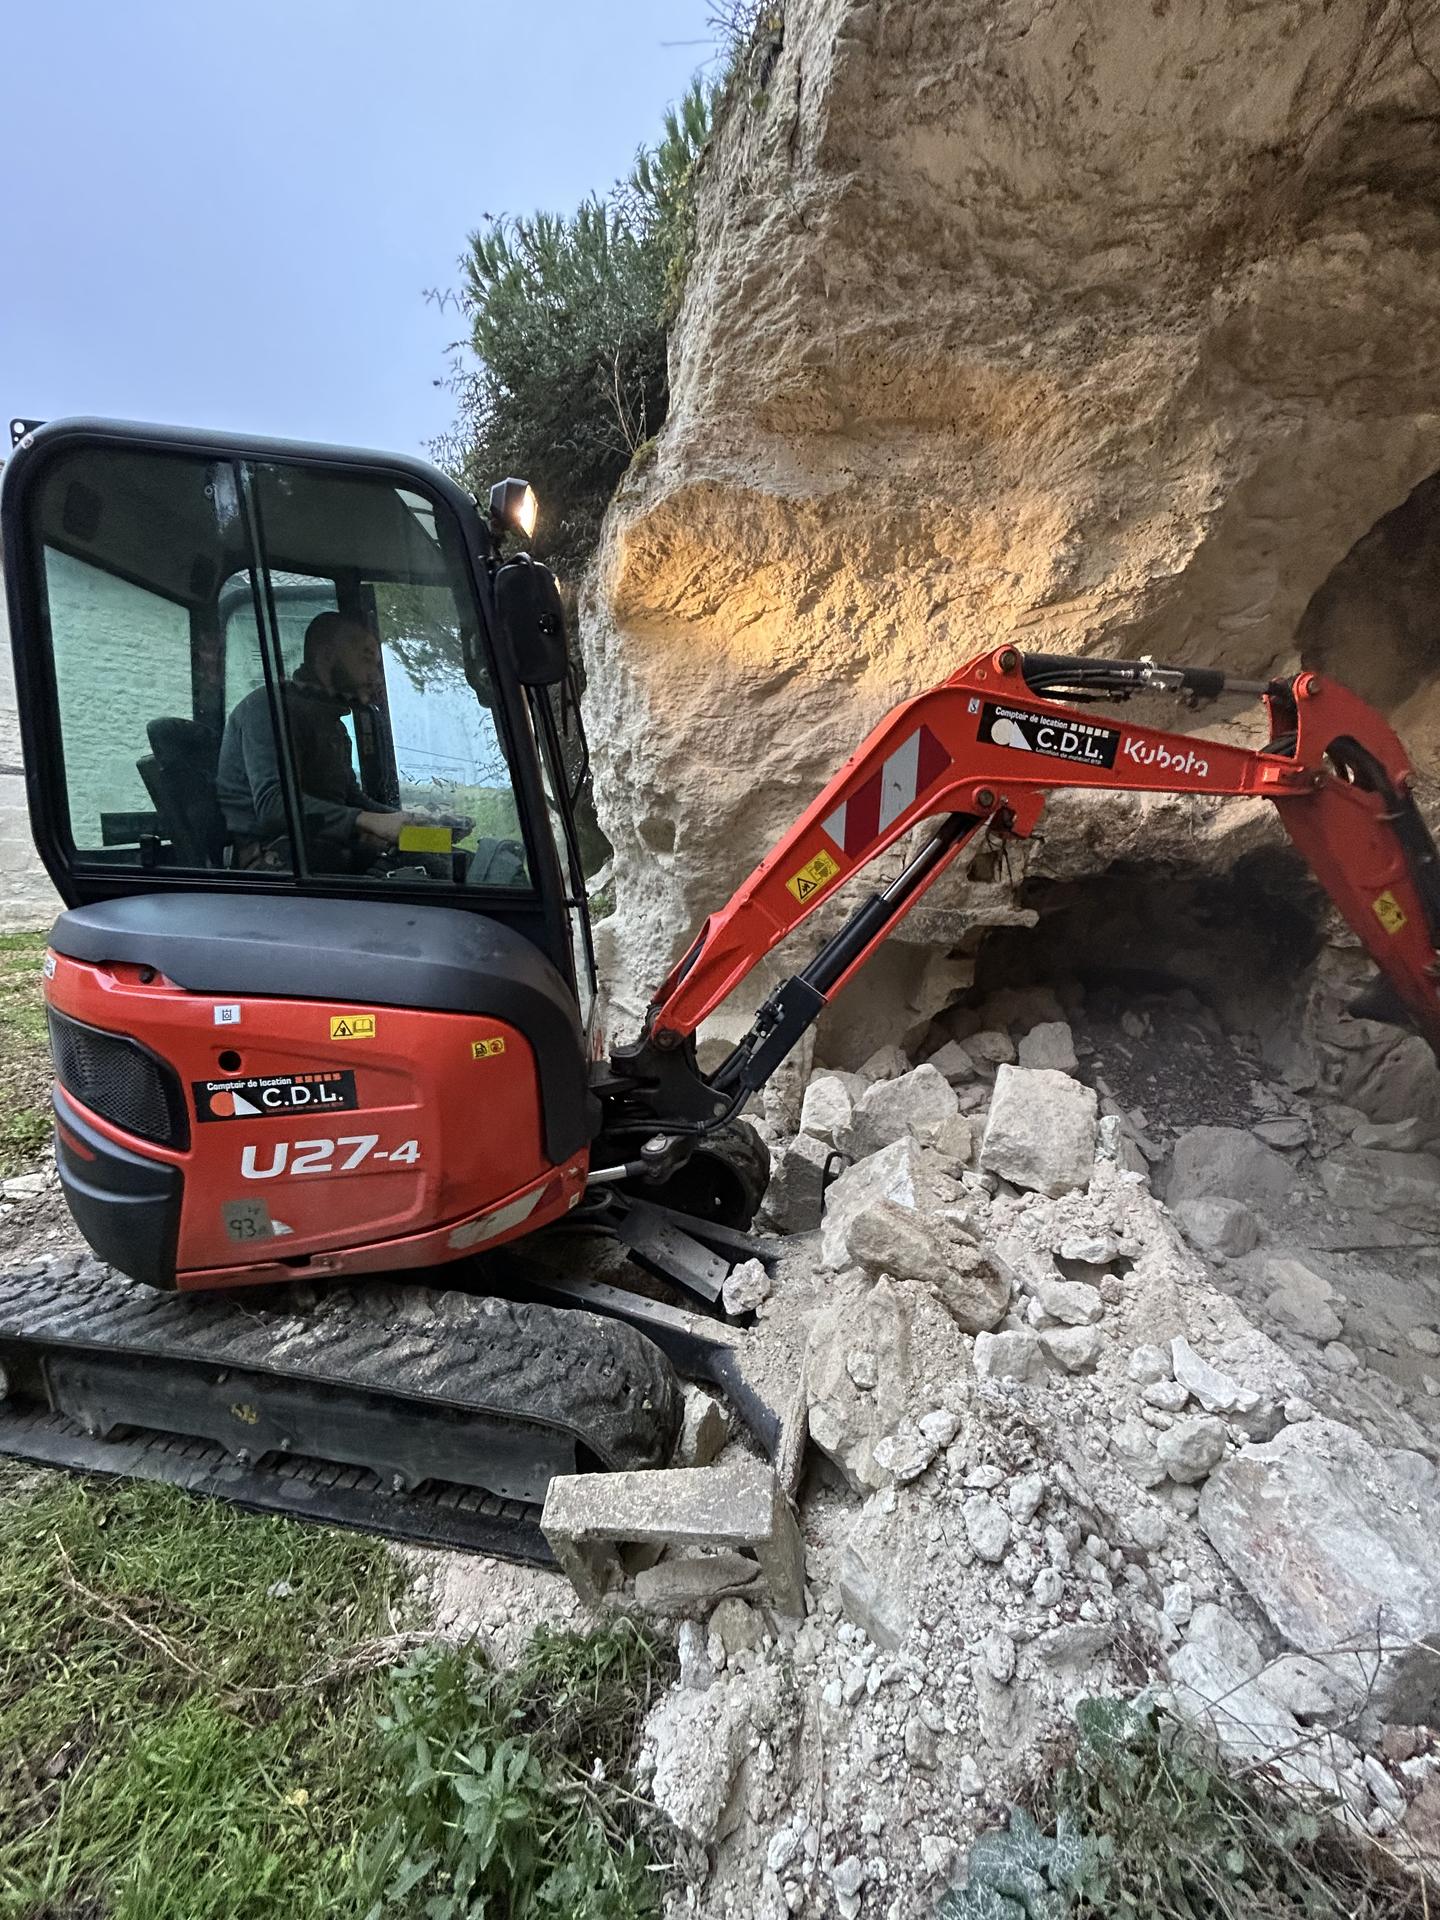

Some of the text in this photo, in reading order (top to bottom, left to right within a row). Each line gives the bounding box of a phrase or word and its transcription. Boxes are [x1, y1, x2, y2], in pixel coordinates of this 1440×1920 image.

[995, 706, 1068, 729] Comptoir de location
[1036, 727, 1104, 760] C.D.L.
[1123, 737, 1209, 777] Kubota
[206, 1077, 292, 1092] Comptoir de location
[262, 1084, 344, 1107] C.D.L.
[240, 1134, 421, 1180] U27-4
[229, 1218, 257, 1238] 93
